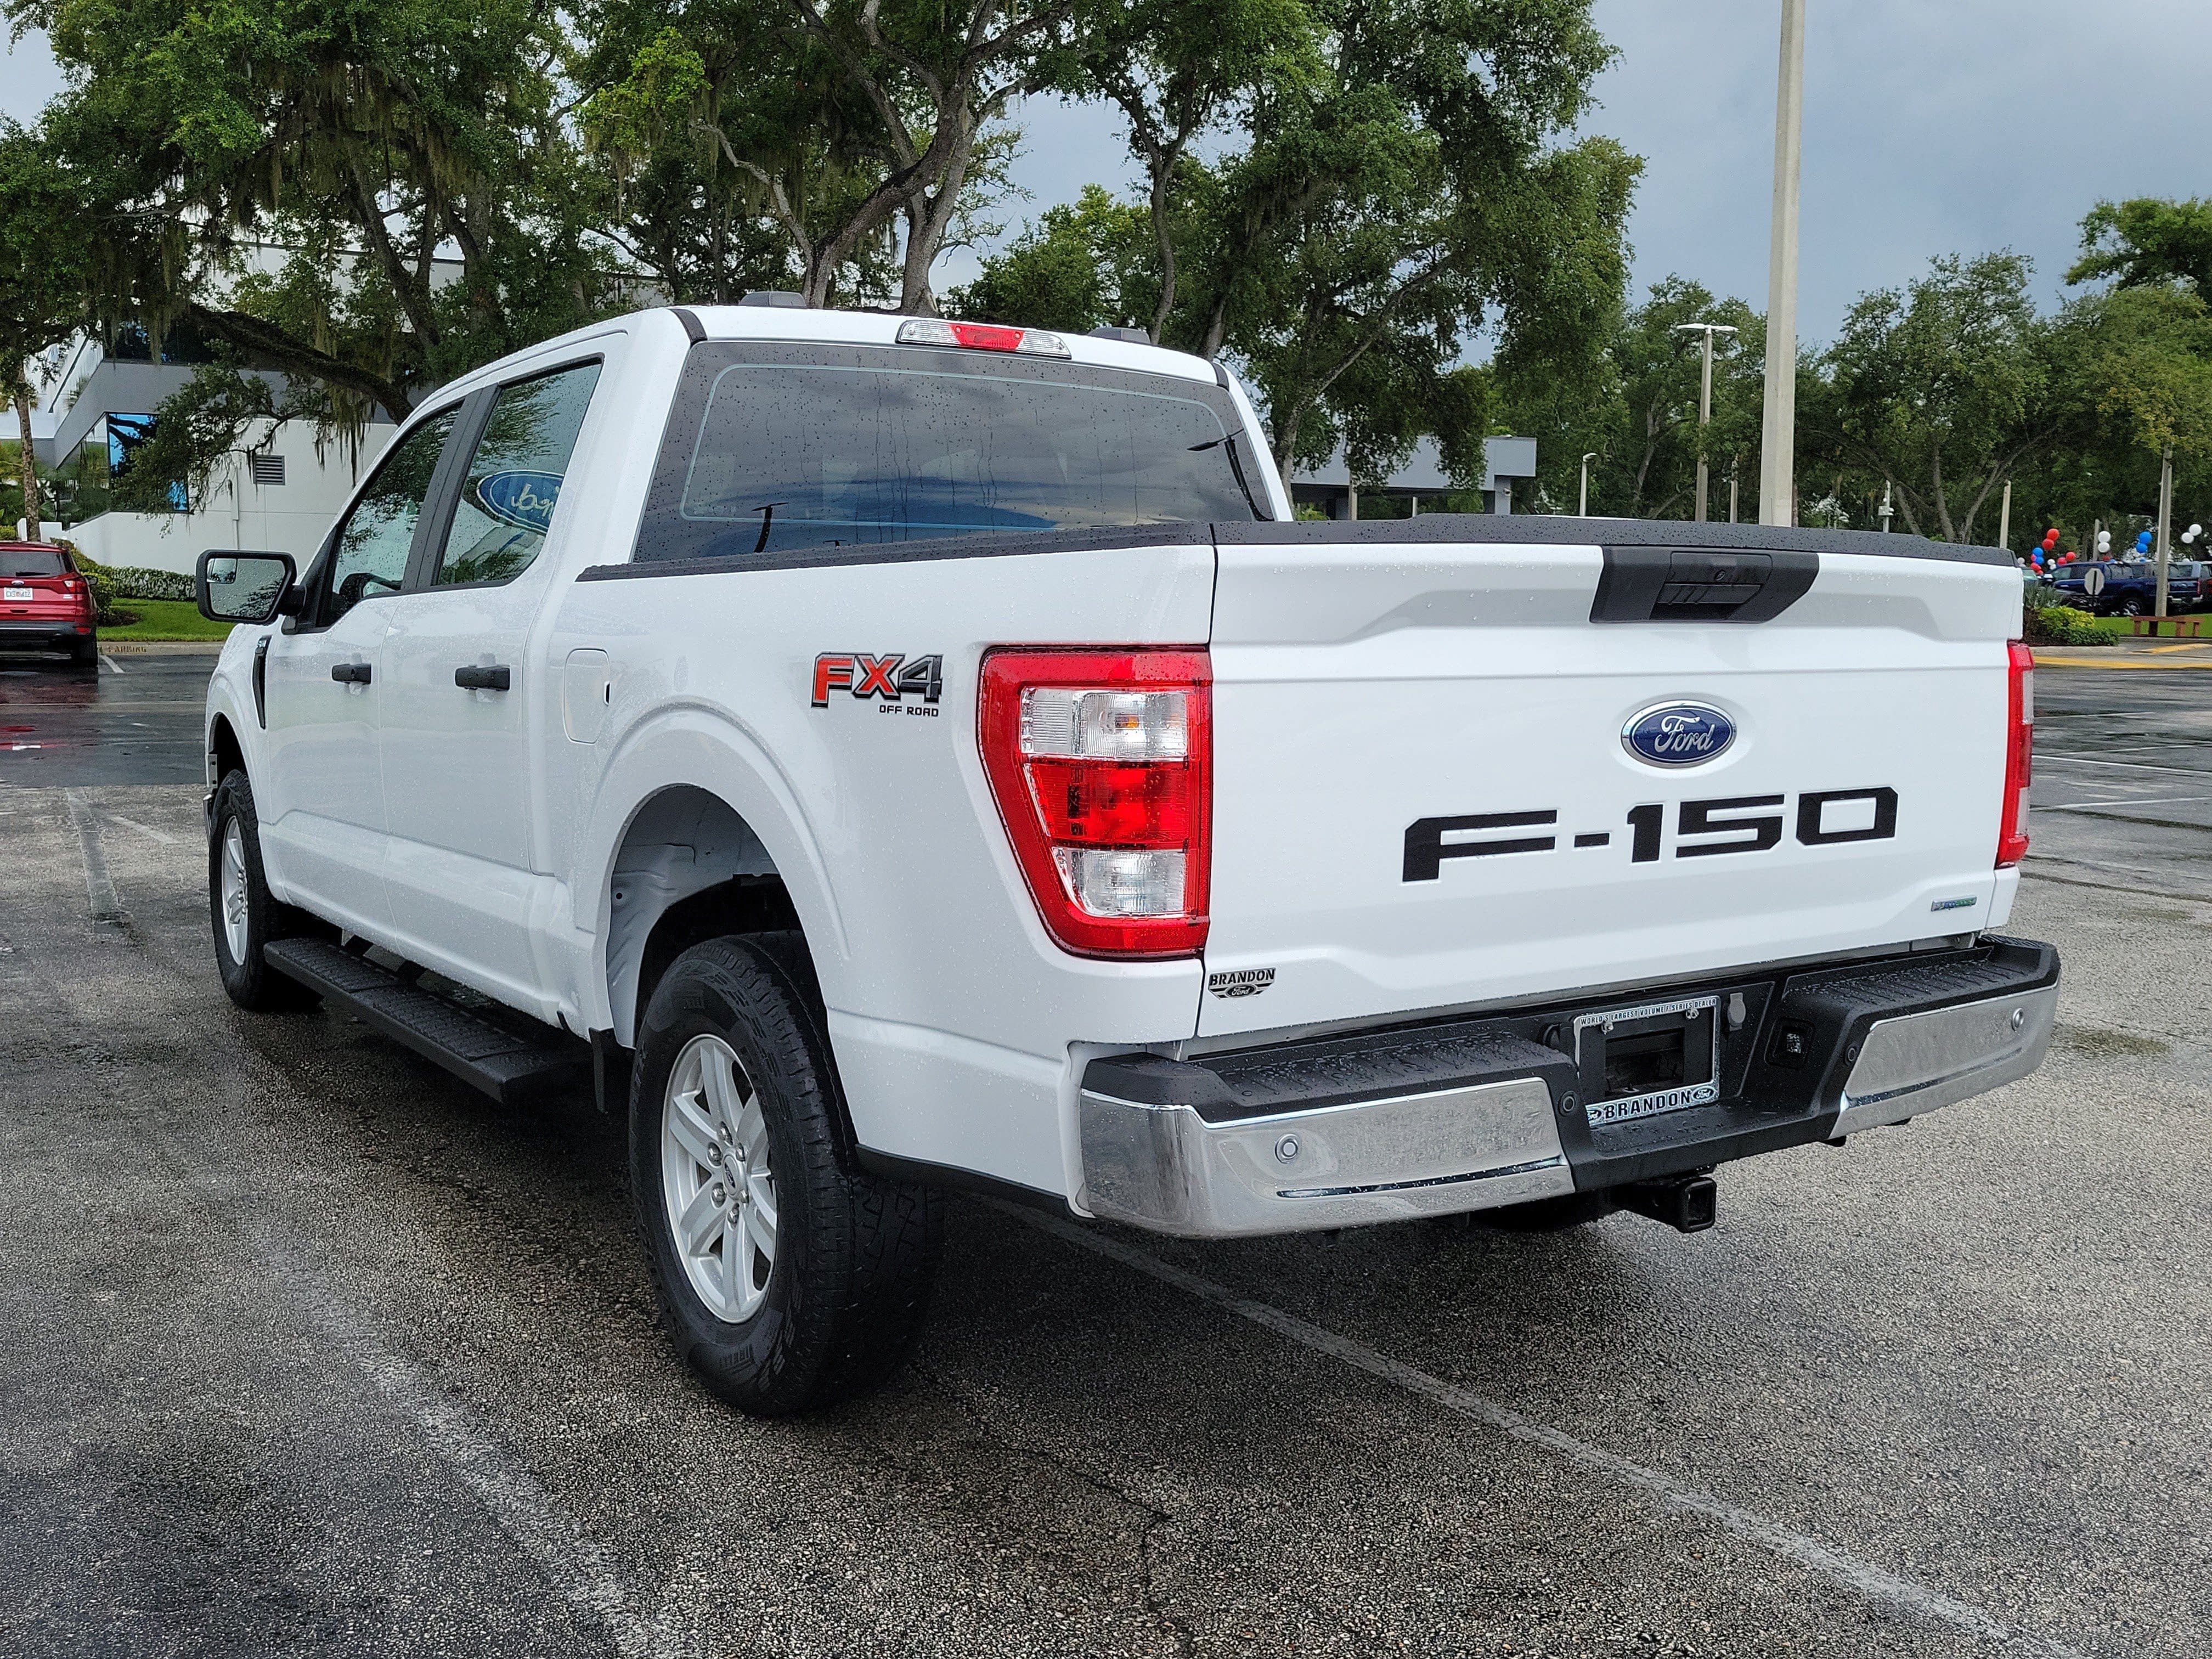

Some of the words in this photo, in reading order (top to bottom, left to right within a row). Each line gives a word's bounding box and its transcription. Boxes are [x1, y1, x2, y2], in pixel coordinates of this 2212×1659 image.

[811, 651, 943, 709] FX4
[879, 704, 902, 714] OFF
[907, 706, 939, 717] ROAD
[1654, 715, 1715, 753] Ford
[1402, 786, 1899, 882] F-150
[1209, 969, 1276, 986] BRANDON
[1231, 986, 1251, 996] Ford
[1581, 1014, 1609, 1025] WORLD'S
[1611, 1010, 1638, 1020] LARGEST
[1640, 1006, 1664, 1016] VOLUME
[1666, 1002, 1692, 1012] F-SERIES
[1694, 998, 1716, 1008] DEALER
[1604, 1090, 1691, 1120] BRANDON
